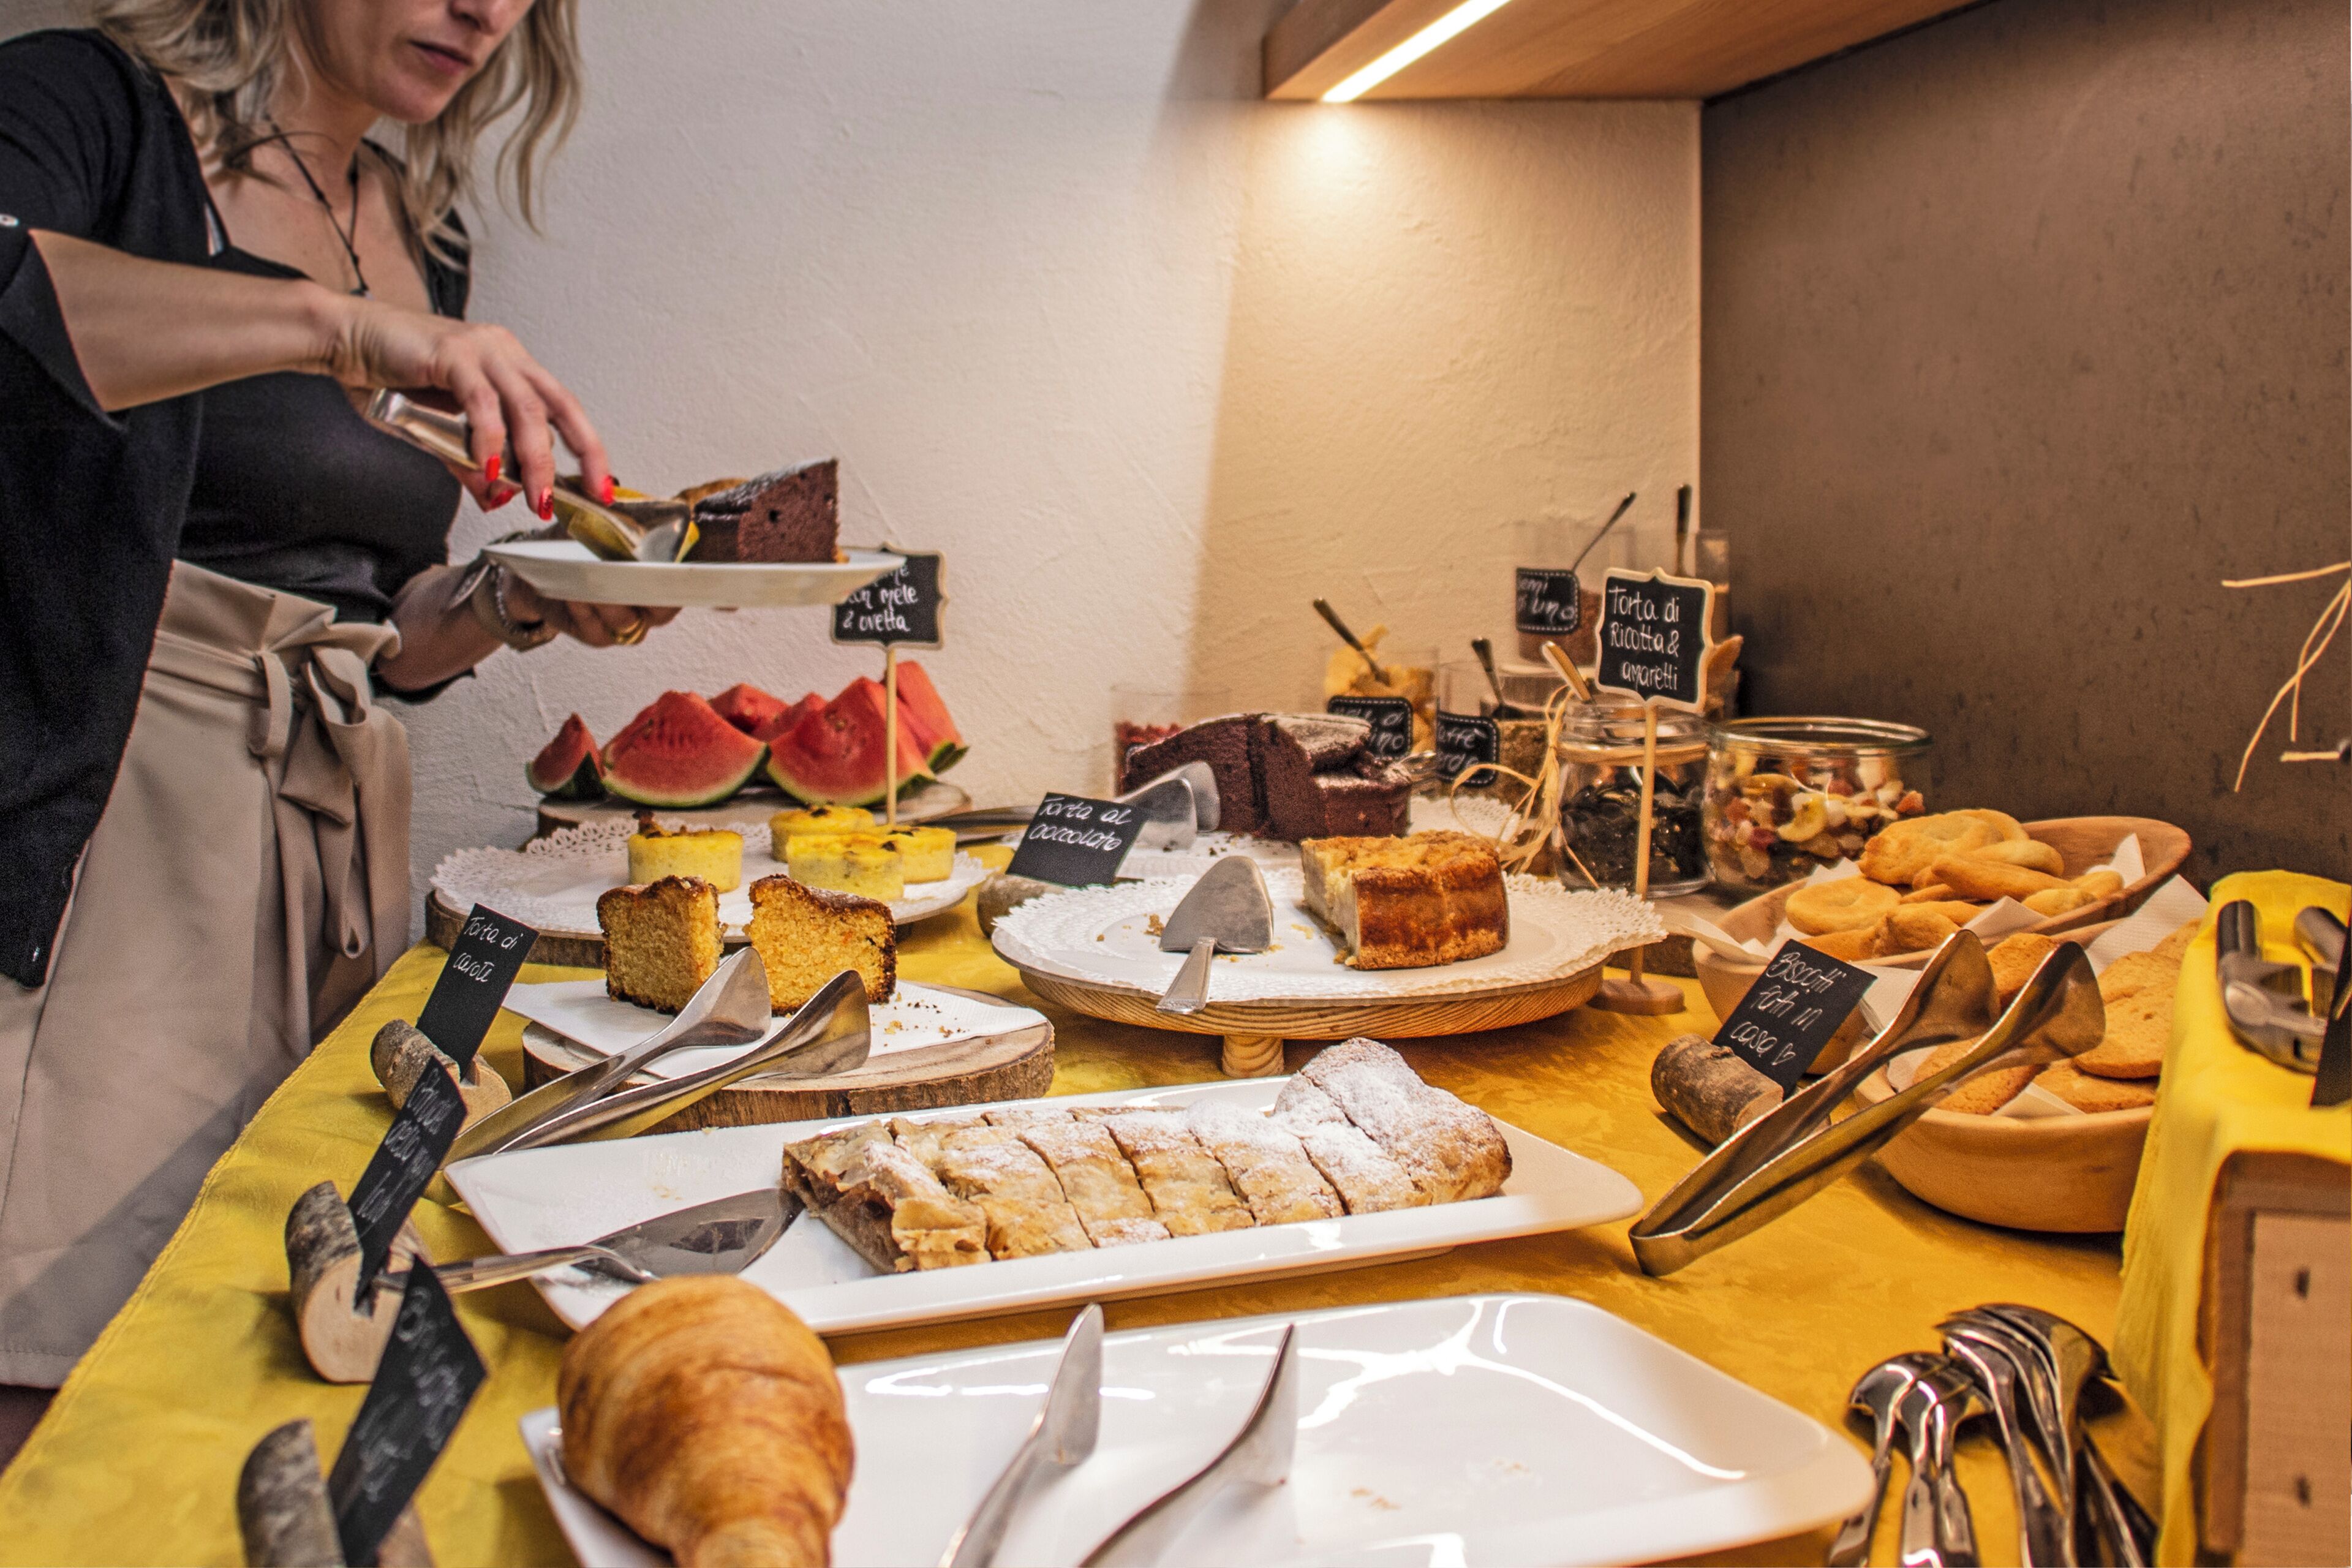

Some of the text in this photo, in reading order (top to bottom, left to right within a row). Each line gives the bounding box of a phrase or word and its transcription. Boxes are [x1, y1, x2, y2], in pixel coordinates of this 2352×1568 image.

[880, 583, 919, 612] mele
[1608, 586, 1681, 623] Torta di
[1610, 621, 1679, 658] Ricotta &
[1622, 660, 1678, 692] amaretti
[1039, 797, 1133, 825] Torta al
[464, 916, 524, 951] Torta di
[1766, 951, 1847, 994] Biscotti
